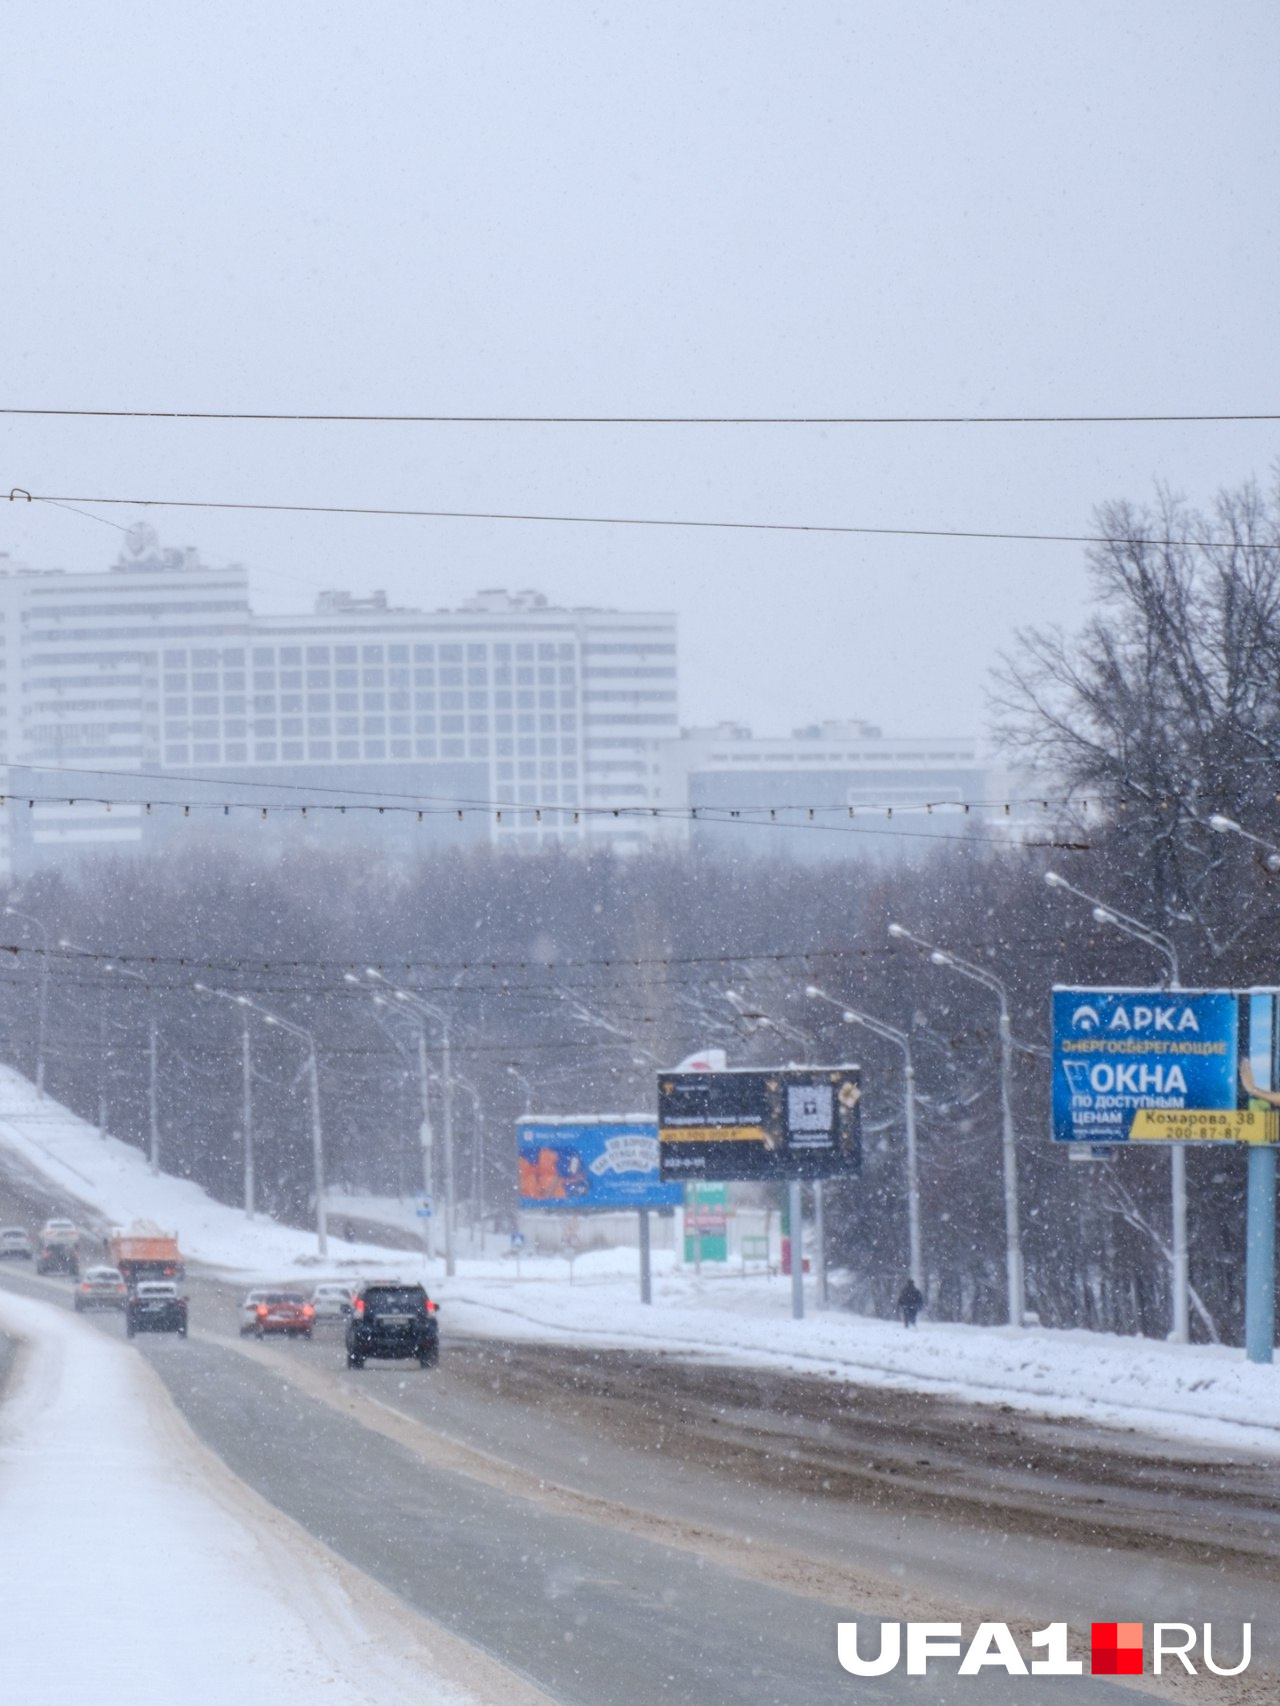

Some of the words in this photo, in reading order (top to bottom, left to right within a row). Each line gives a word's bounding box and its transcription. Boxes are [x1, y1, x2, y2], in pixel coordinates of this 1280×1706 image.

[1108, 1005, 1200, 1032] АРКА
[1061, 1038, 1227, 1056] ЭНЕРГОСБЕРЕГАЮЩИЕ
[1090, 1063, 1188, 1094] ОКНА
[1072, 1094, 1092, 1108] ПО
[1094, 1094, 1185, 1110] ДОСТУПНЫМ
[1071, 1110, 1123, 1126] ЦЕНАМ
[1236, 1112, 1255, 1125] 38
[1166, 1127, 1241, 1139] 200-87-87
